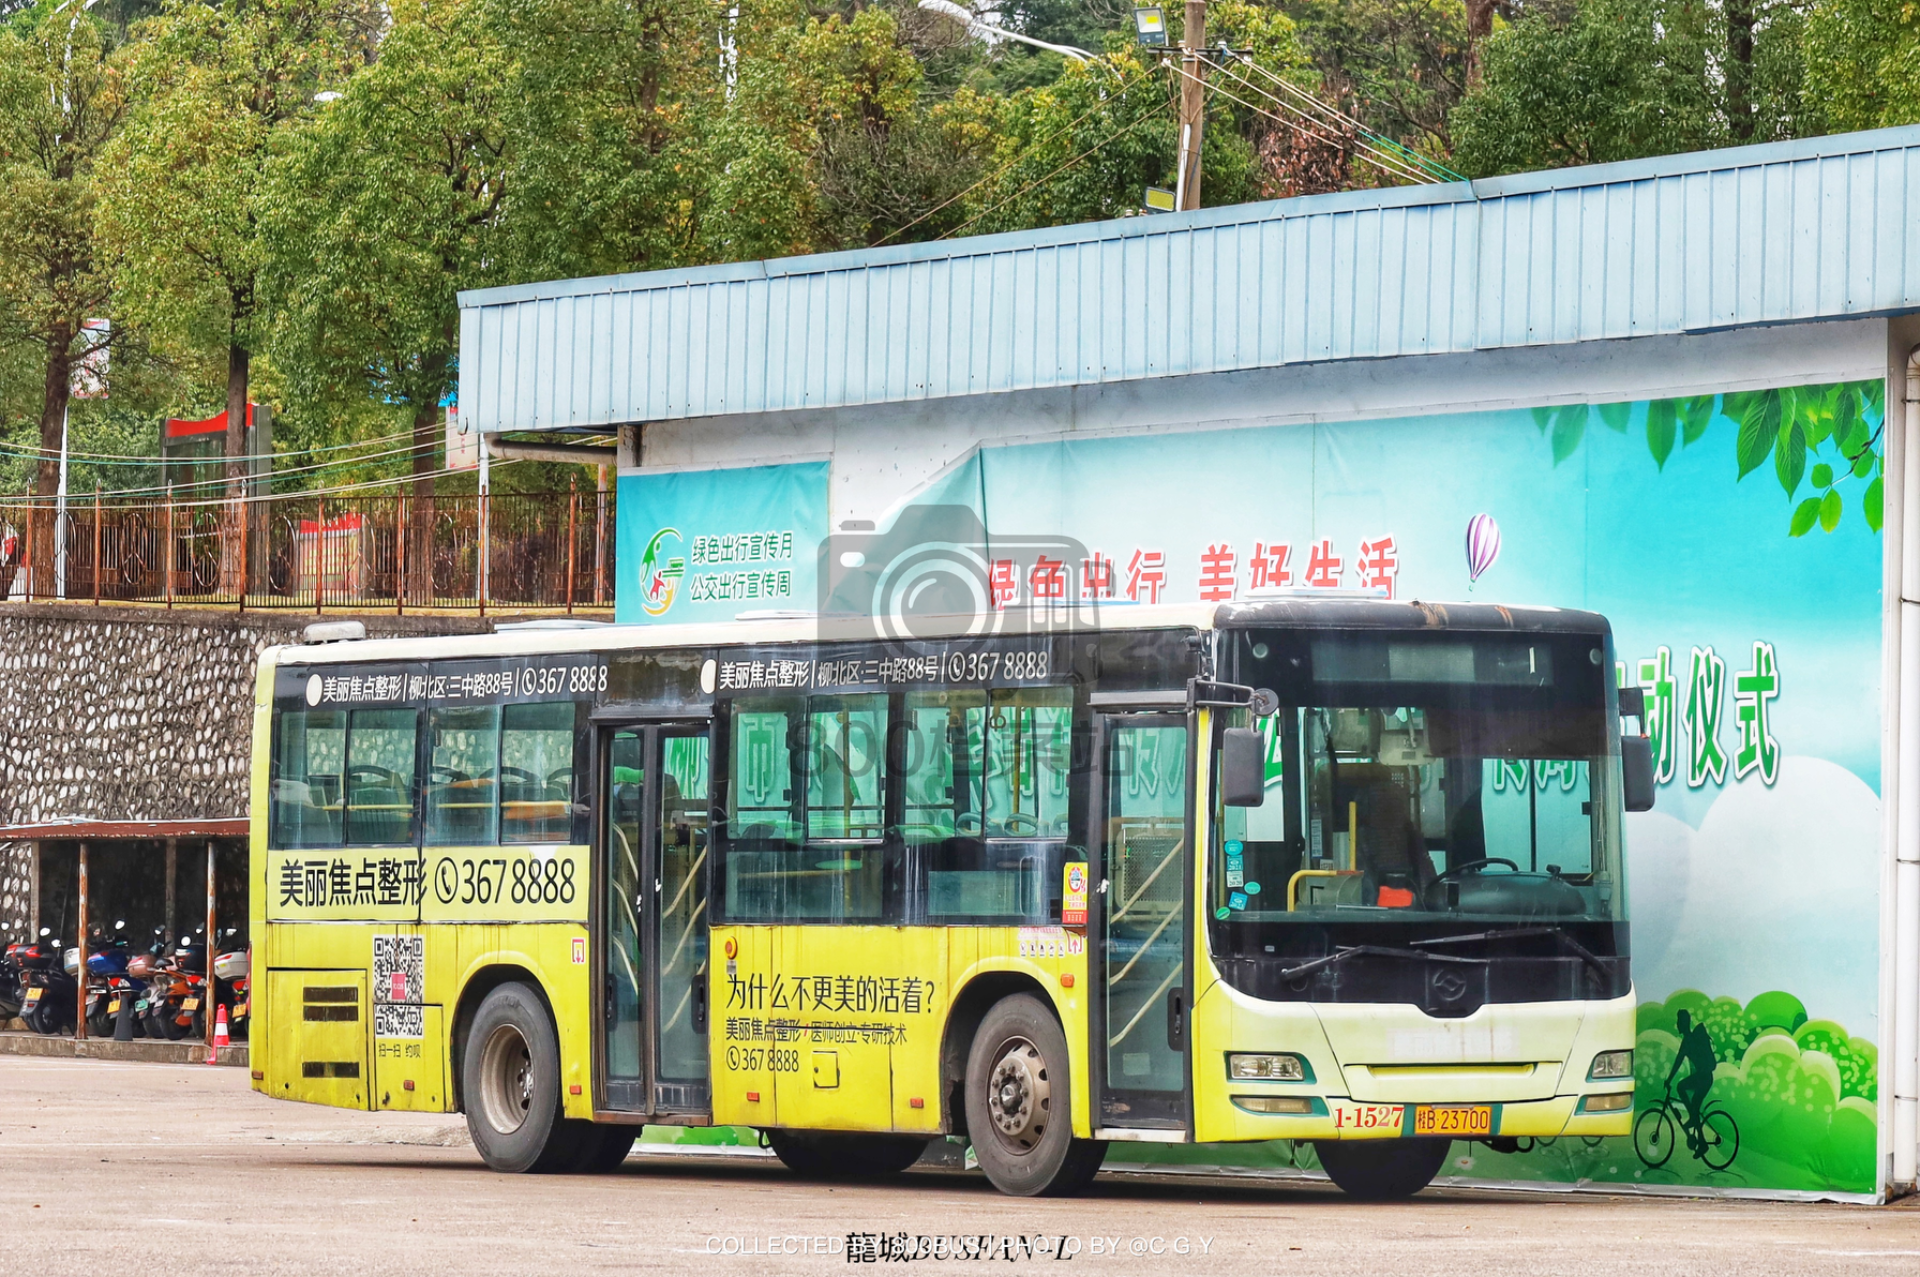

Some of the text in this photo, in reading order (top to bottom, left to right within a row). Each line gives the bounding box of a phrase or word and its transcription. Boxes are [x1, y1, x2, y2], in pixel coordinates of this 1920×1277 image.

[691, 532, 794, 564] 绿色出行宣传月
[690, 568, 792, 601] 公交出行宣传周
[1199, 537, 1398, 602] 美好生活
[322, 675, 402, 702] 美丽焦点整形
[719, 659, 810, 690] 美丽焦点整形
[1617, 644, 1777, 783] 动仪式
[279, 857, 428, 907] 美丽焦点整形
[726, 973, 935, 1014] 为什么不更美的活着?
[1334, 1105, 1405, 1129] 1-1527
